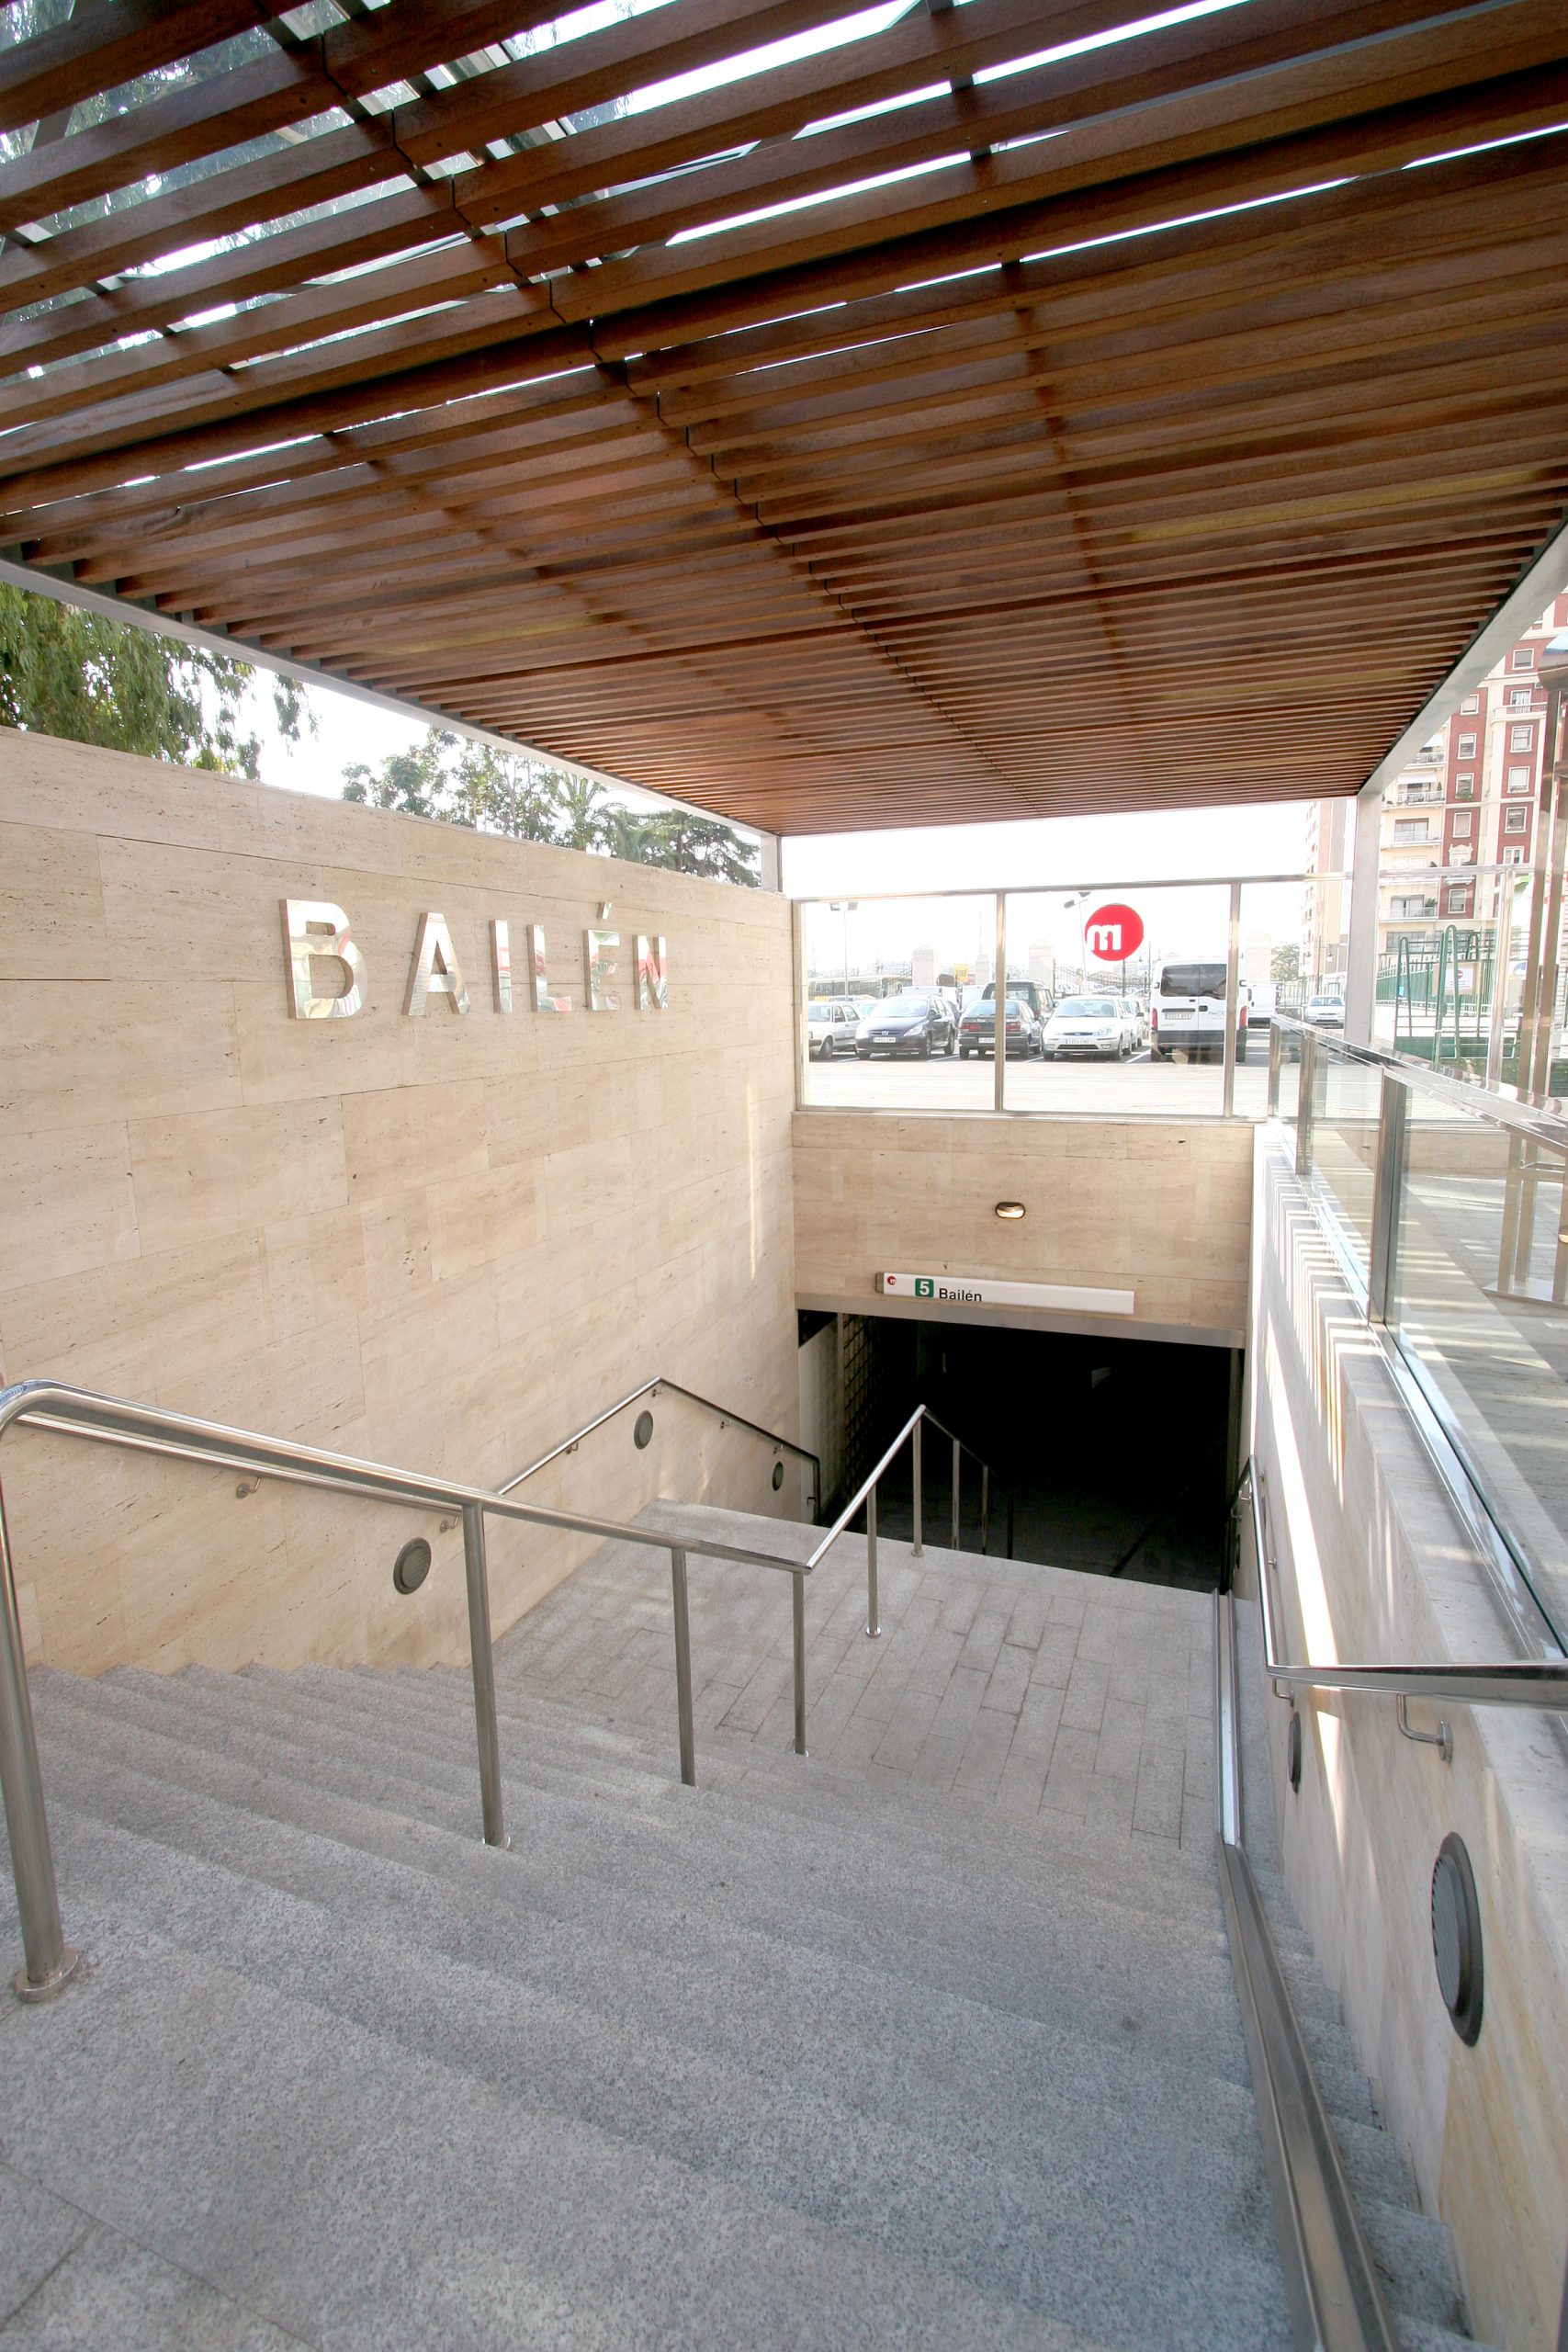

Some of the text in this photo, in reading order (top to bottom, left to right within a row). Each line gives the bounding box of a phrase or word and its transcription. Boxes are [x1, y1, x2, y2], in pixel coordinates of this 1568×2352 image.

[1086, 923, 1123, 951] m
[279, 899, 669, 1020] BAILÉN
[919, 1281, 931, 1296] 5
[939, 1288, 982, 1302] Bailén
